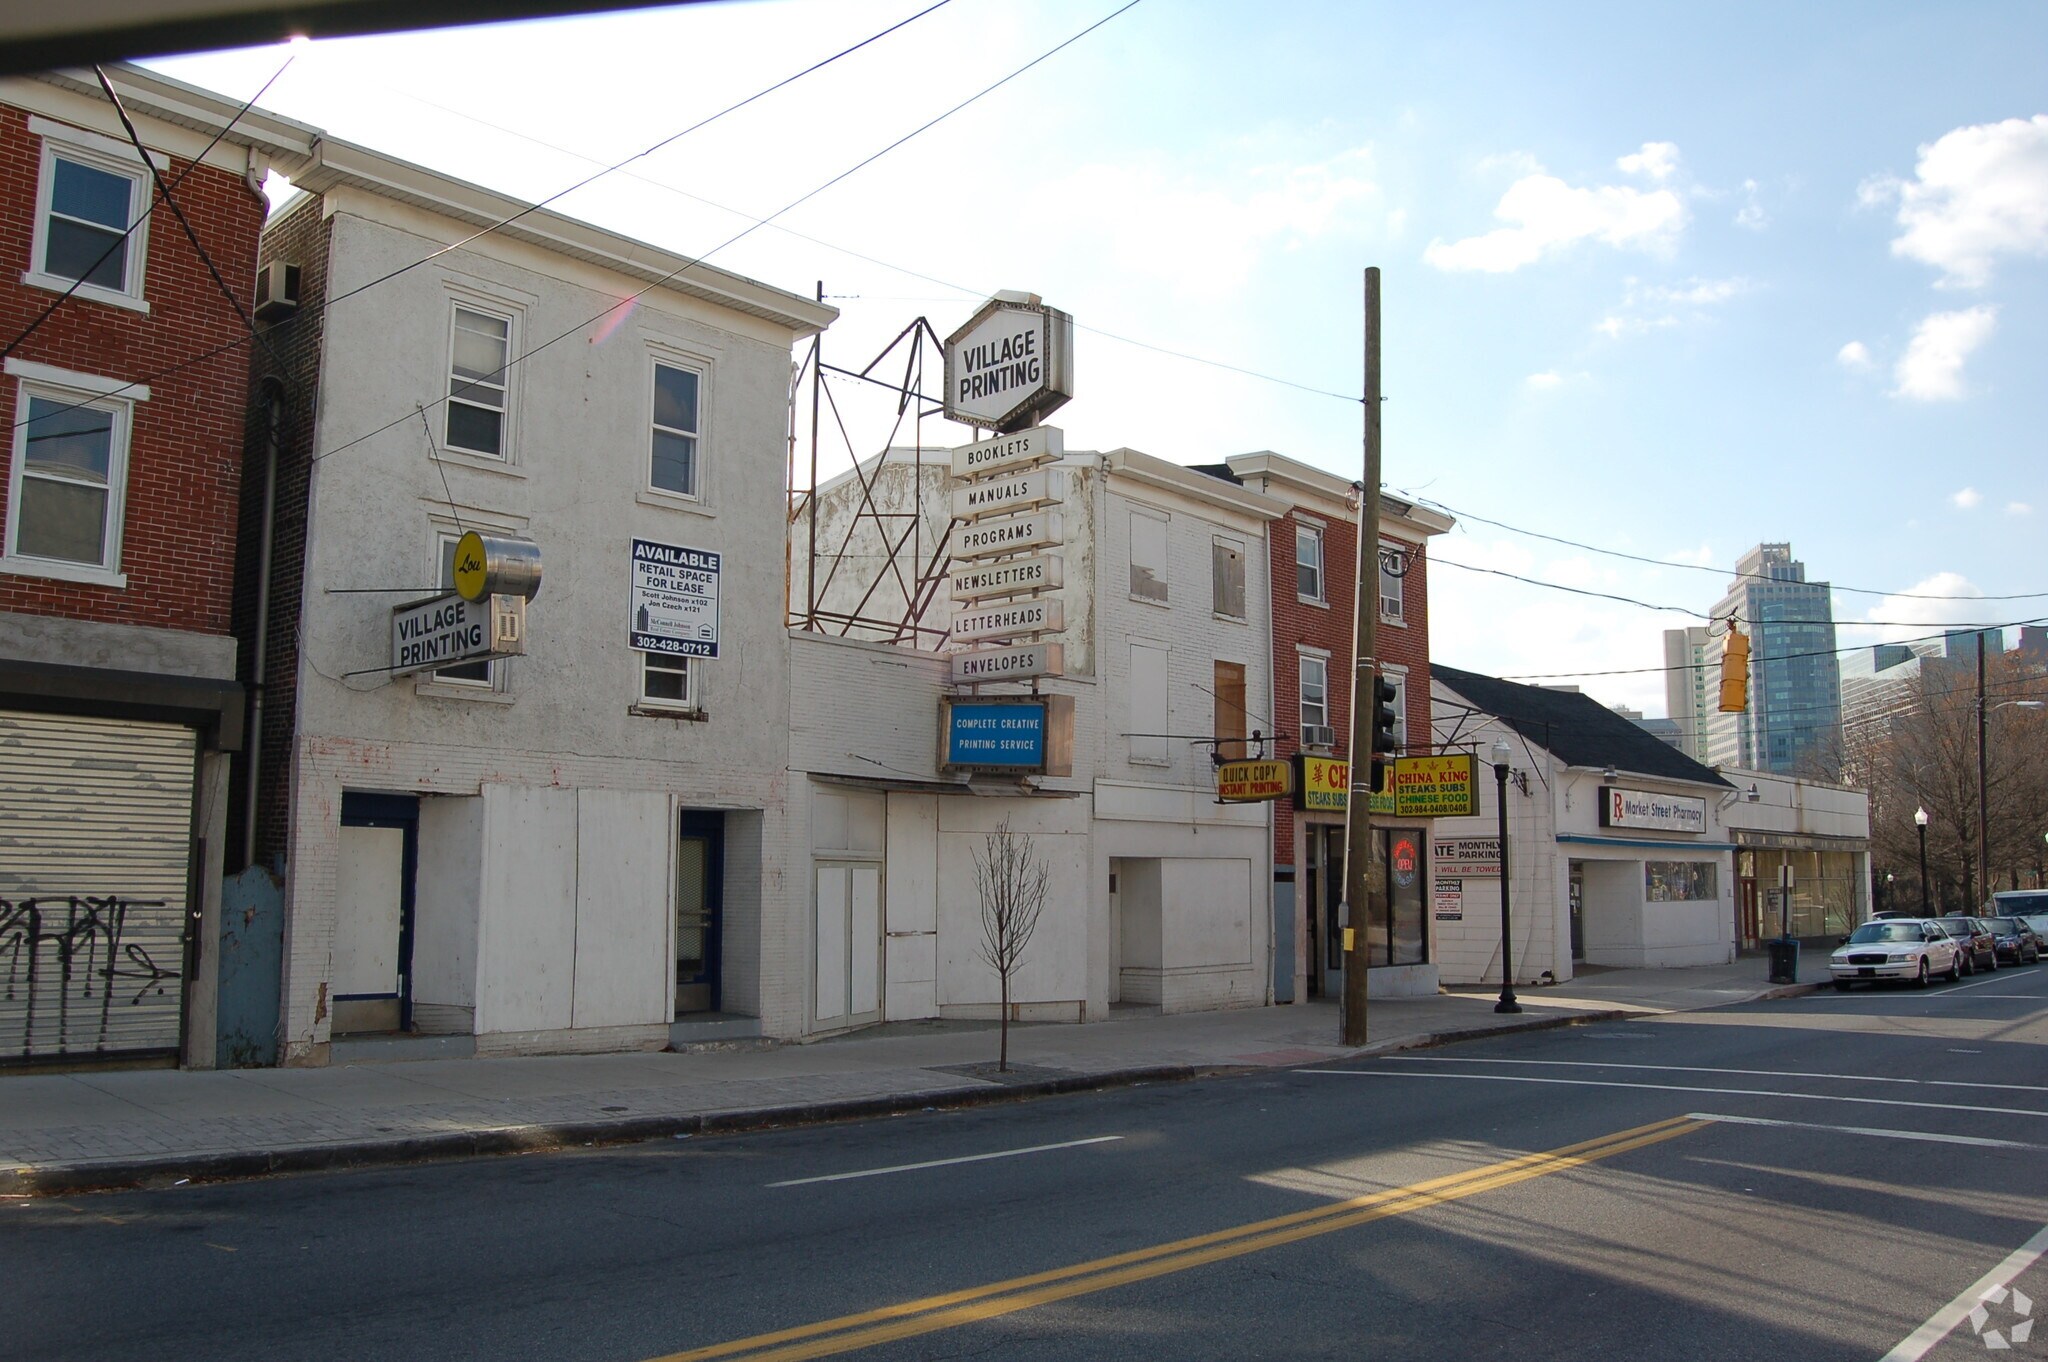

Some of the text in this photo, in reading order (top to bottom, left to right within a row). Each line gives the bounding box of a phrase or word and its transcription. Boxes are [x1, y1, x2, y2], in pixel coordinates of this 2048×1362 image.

[964, 330, 1035, 373] VILLAGE
[960, 358, 1040, 403] PRINTING
[968, 438, 1030, 465] BOOKLETS
[968, 482, 1028, 506] MANUALS
[964, 523, 1033, 549] PROGRAMS
[458, 553, 482, 574] Lou
[635, 544, 718, 570] AVAILABLE
[639, 562, 713, 583] RETAIL SPACE
[956, 564, 1042, 592] NEWSLETTERS
[646, 576, 704, 594] FOR LEASE
[642, 590, 708, 607] Scott Johnson x102
[662, 602, 682, 611] Czech
[399, 601, 466, 641] VILLAGE
[956, 608, 1042, 633] LETTERHEADS
[401, 624, 482, 667] PRINTING
[637, 636, 710, 655] 302-428-0712
[963, 654, 1034, 674] ENVELOPES
[956, 719, 1039, 729] COMPLETE CREATIVE
[959, 739, 1034, 750] PRINTING SERVICE
[1223, 765, 1277, 783] QUICK COPY
[1397, 772, 1434, 784] CHINA
[1439, 771, 1468, 783] KING
[1219, 781, 1283, 795] INSTANT PRINTING
[1399, 783, 1465, 794] STEAKS SUBS
[1307, 791, 1331, 806] STEAKS
[1399, 793, 1469, 804] CHINESE FOOD
[1625, 800, 1649, 816] Market
[1651, 803, 1671, 818] Street
[1673, 804, 1703, 825] Pharmacy
